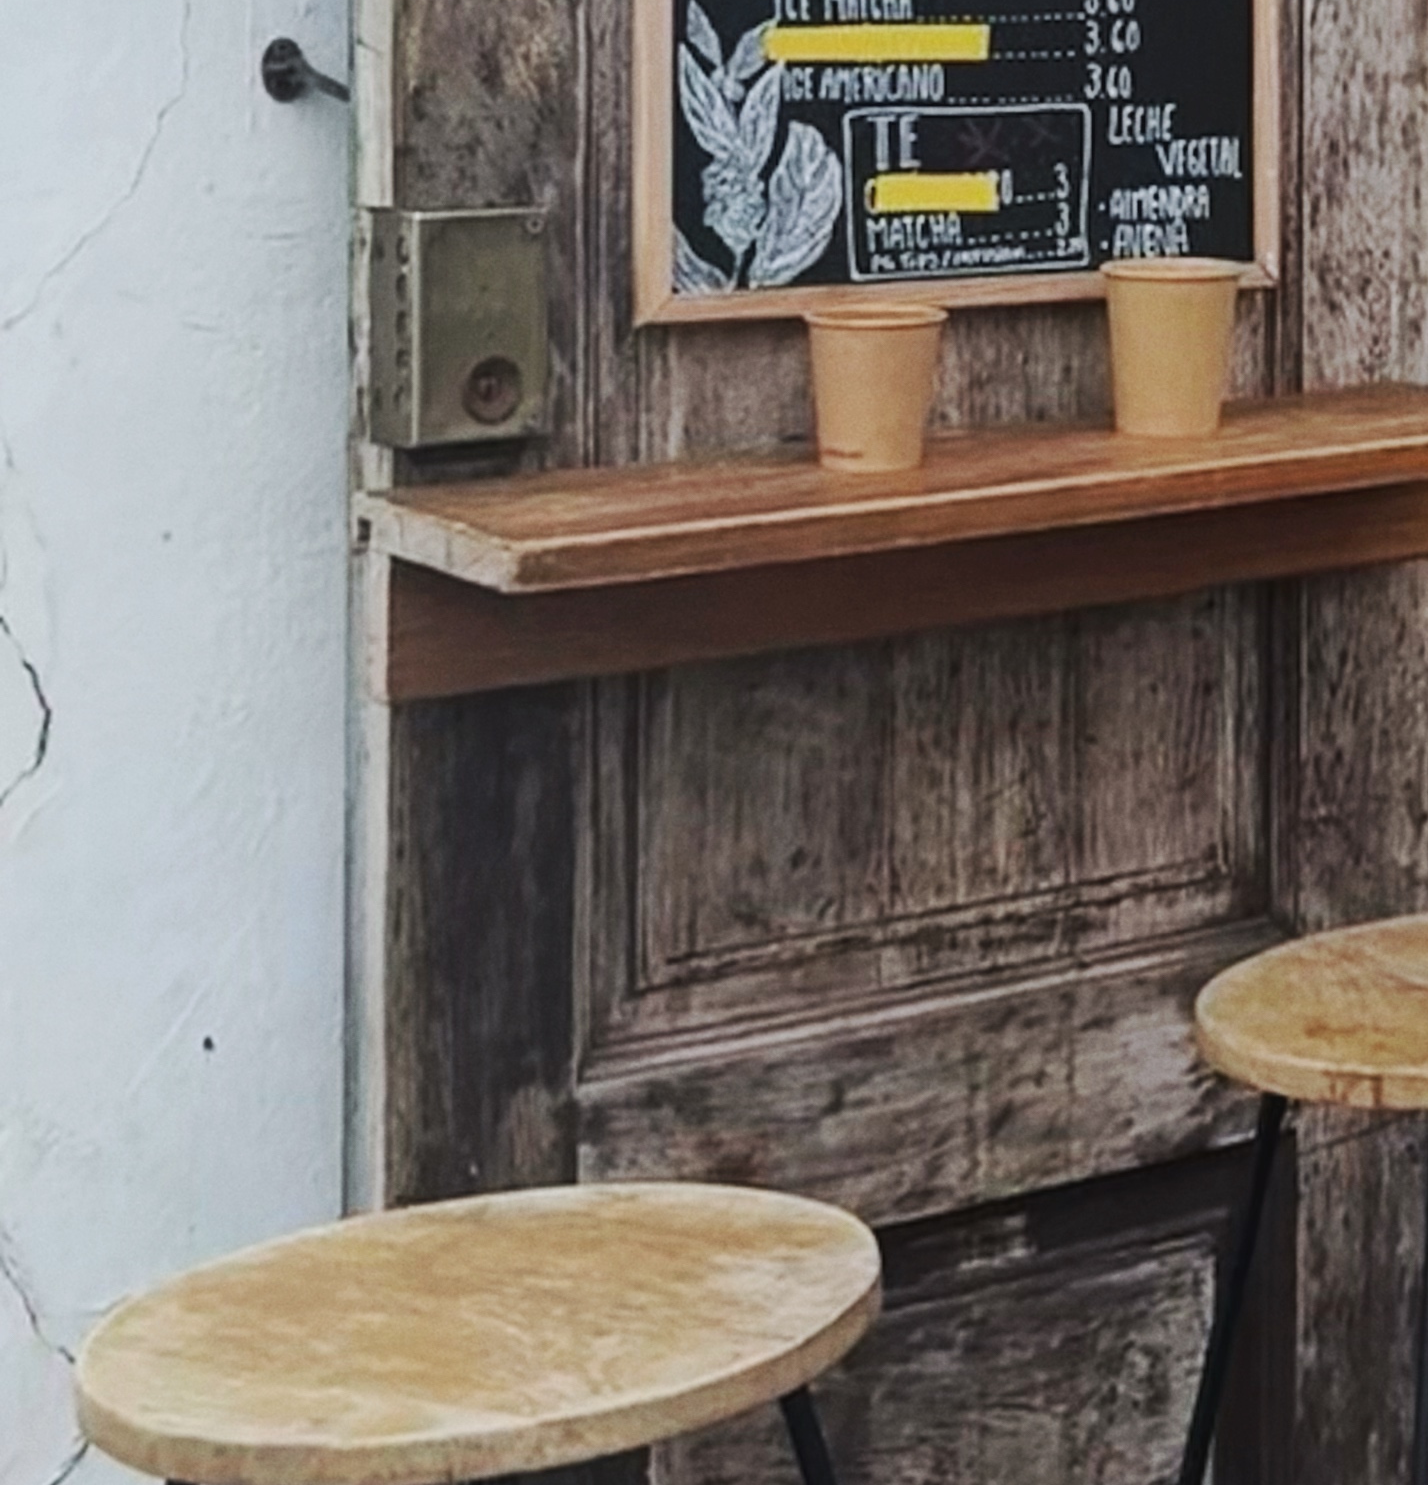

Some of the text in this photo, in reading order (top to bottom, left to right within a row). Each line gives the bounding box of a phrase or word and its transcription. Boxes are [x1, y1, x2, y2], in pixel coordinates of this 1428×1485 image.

[819, 63, 947, 104] AMERICANO
[1108, 102, 1177, 146] LECHE
[866, 212, 963, 253] MATCHA
